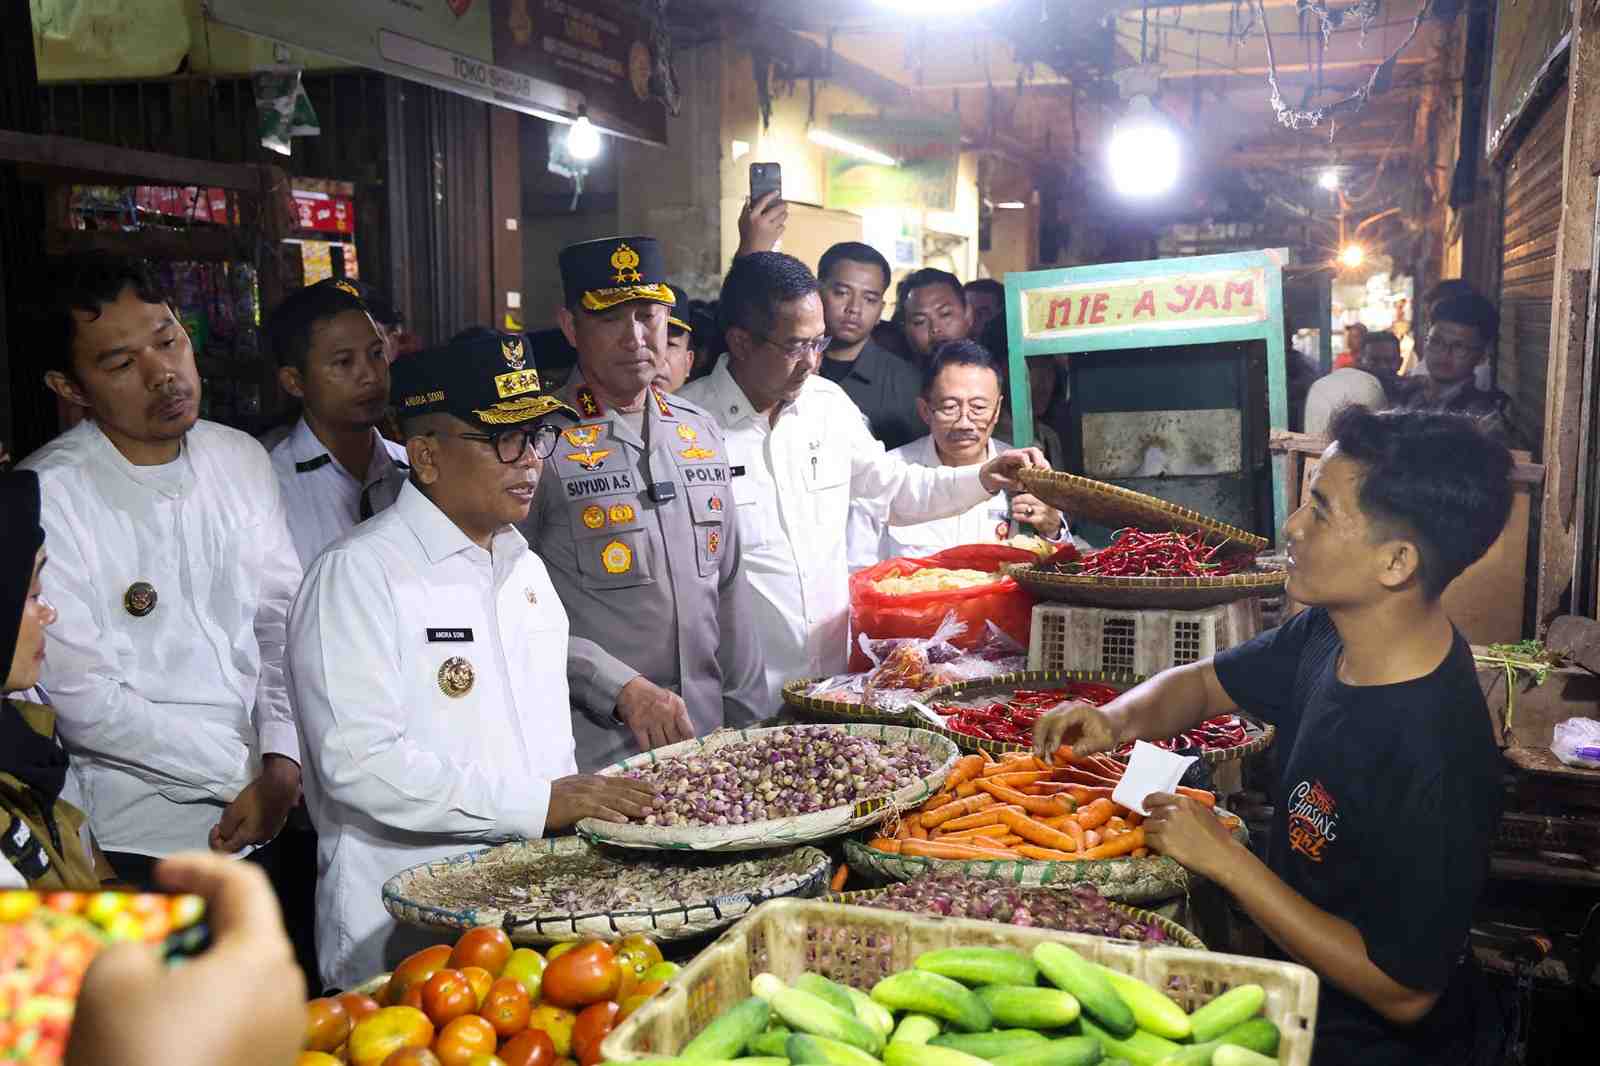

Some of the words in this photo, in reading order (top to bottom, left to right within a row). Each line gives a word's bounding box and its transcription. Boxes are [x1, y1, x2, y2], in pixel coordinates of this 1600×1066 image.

[452, 55, 485, 81] TOKO
[685, 468, 725, 482] POLRI
[567, 477, 611, 496] SUYUDI
